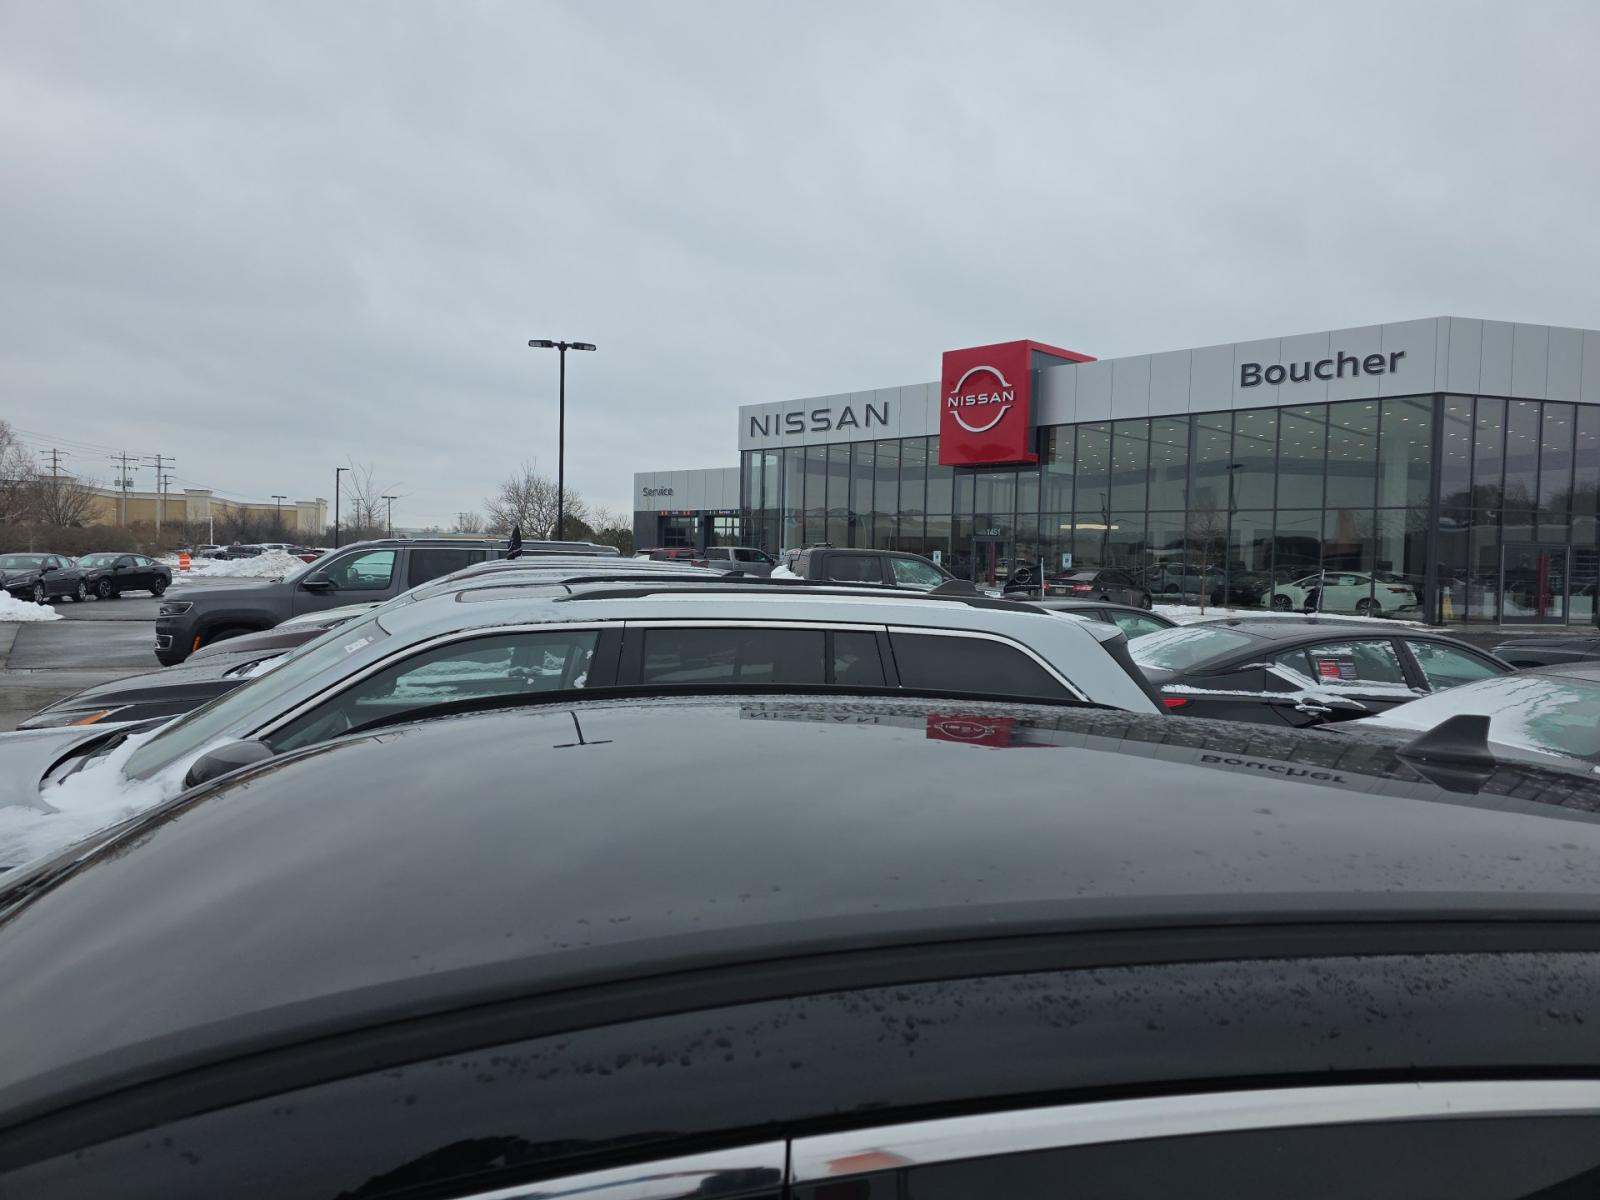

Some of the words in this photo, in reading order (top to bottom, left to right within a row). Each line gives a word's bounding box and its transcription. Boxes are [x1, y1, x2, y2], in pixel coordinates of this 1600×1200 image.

[1240, 351, 1407, 388] Boucher
[947, 390, 1014, 408] NISSAN
[750, 401, 889, 437] NISSAN
[642, 486, 674, 497] Service
